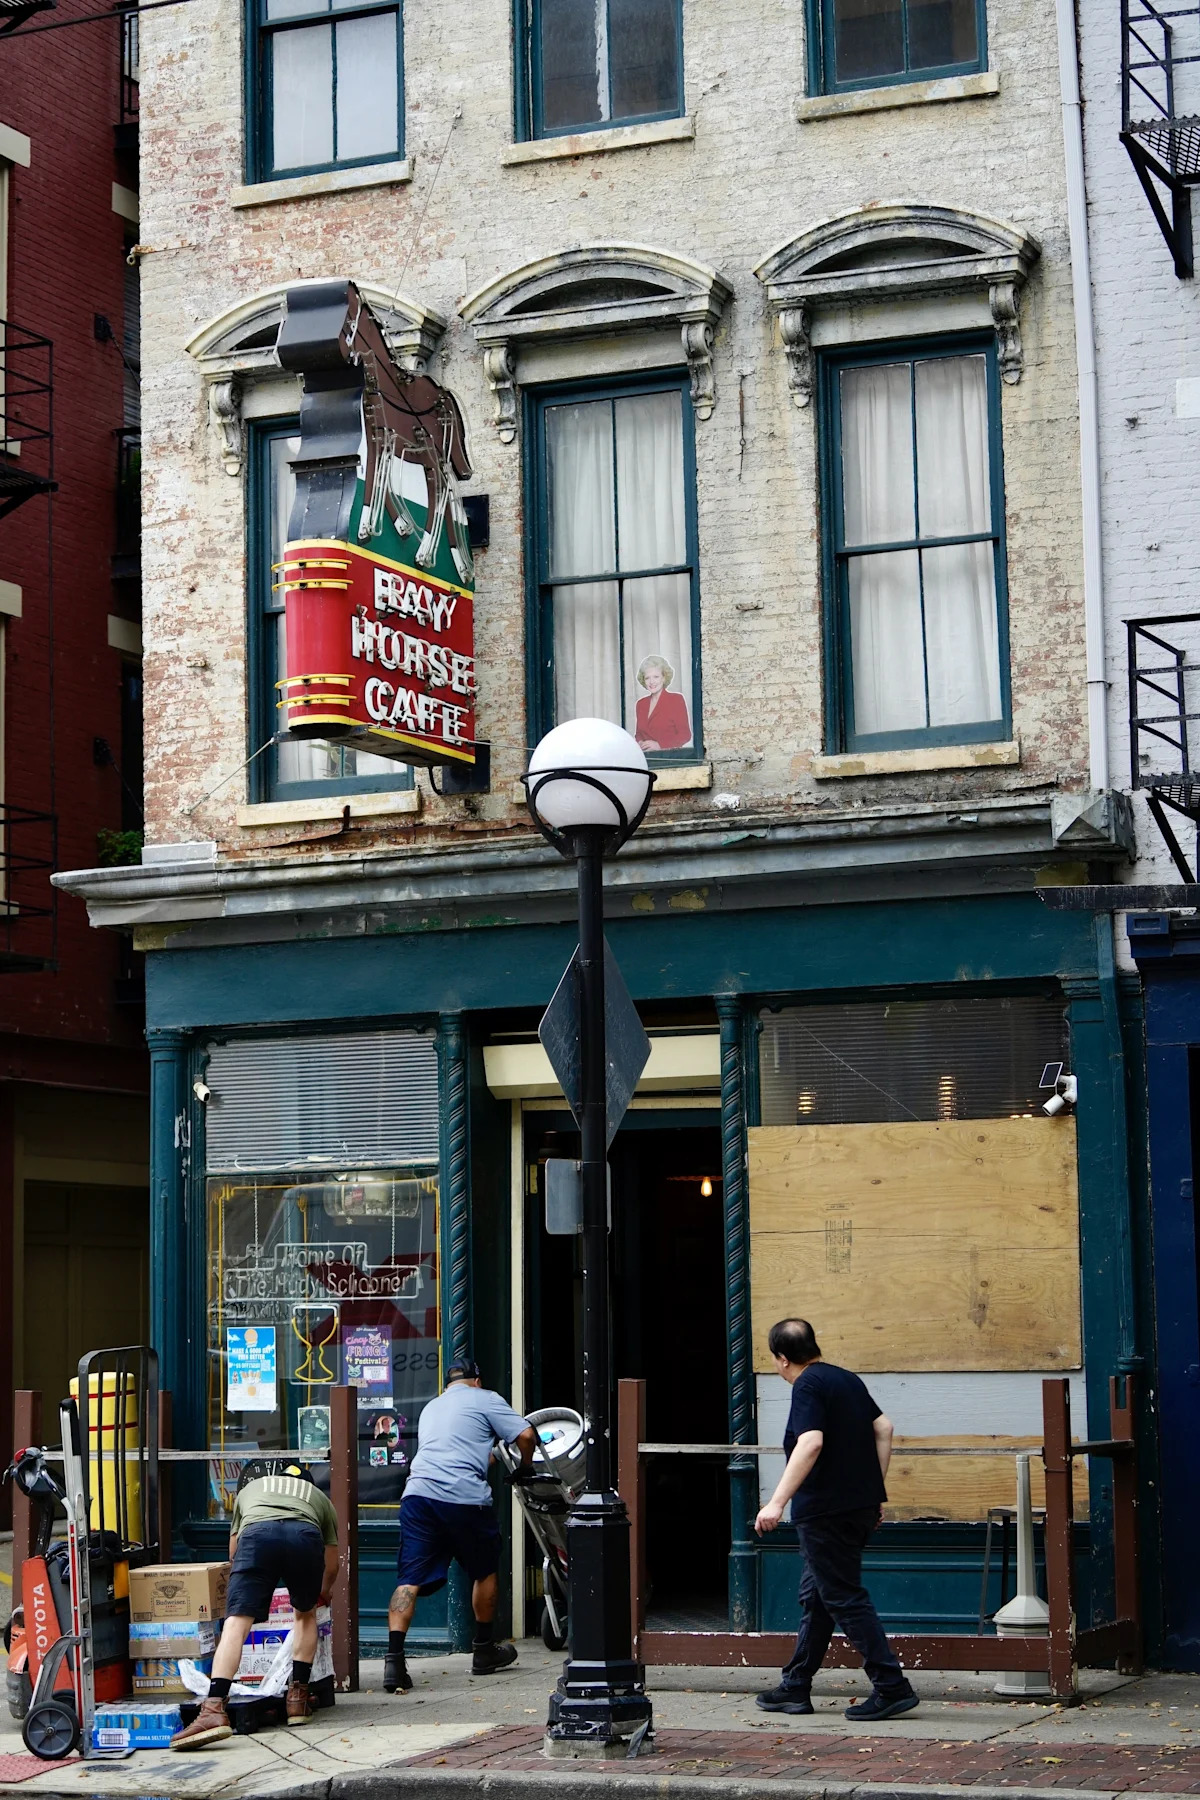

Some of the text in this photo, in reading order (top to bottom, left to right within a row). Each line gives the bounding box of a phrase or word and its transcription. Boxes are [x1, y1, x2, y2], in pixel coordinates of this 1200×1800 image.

[373, 567, 457, 632] BAY
[352, 606, 478, 695] HORSE
[365, 677, 469, 746] CAFE
[281, 1246, 335, 1267] Home
[342, 1245, 364, 1266] Of
[345, 1336, 368, 1345] Cincy
[347, 1345, 387, 1357] FRINGE
[254, 1465, 260, 1473] 11
[264, 1461, 271, 1469] 12
[33, 1583, 48, 1660] TOYOTA
